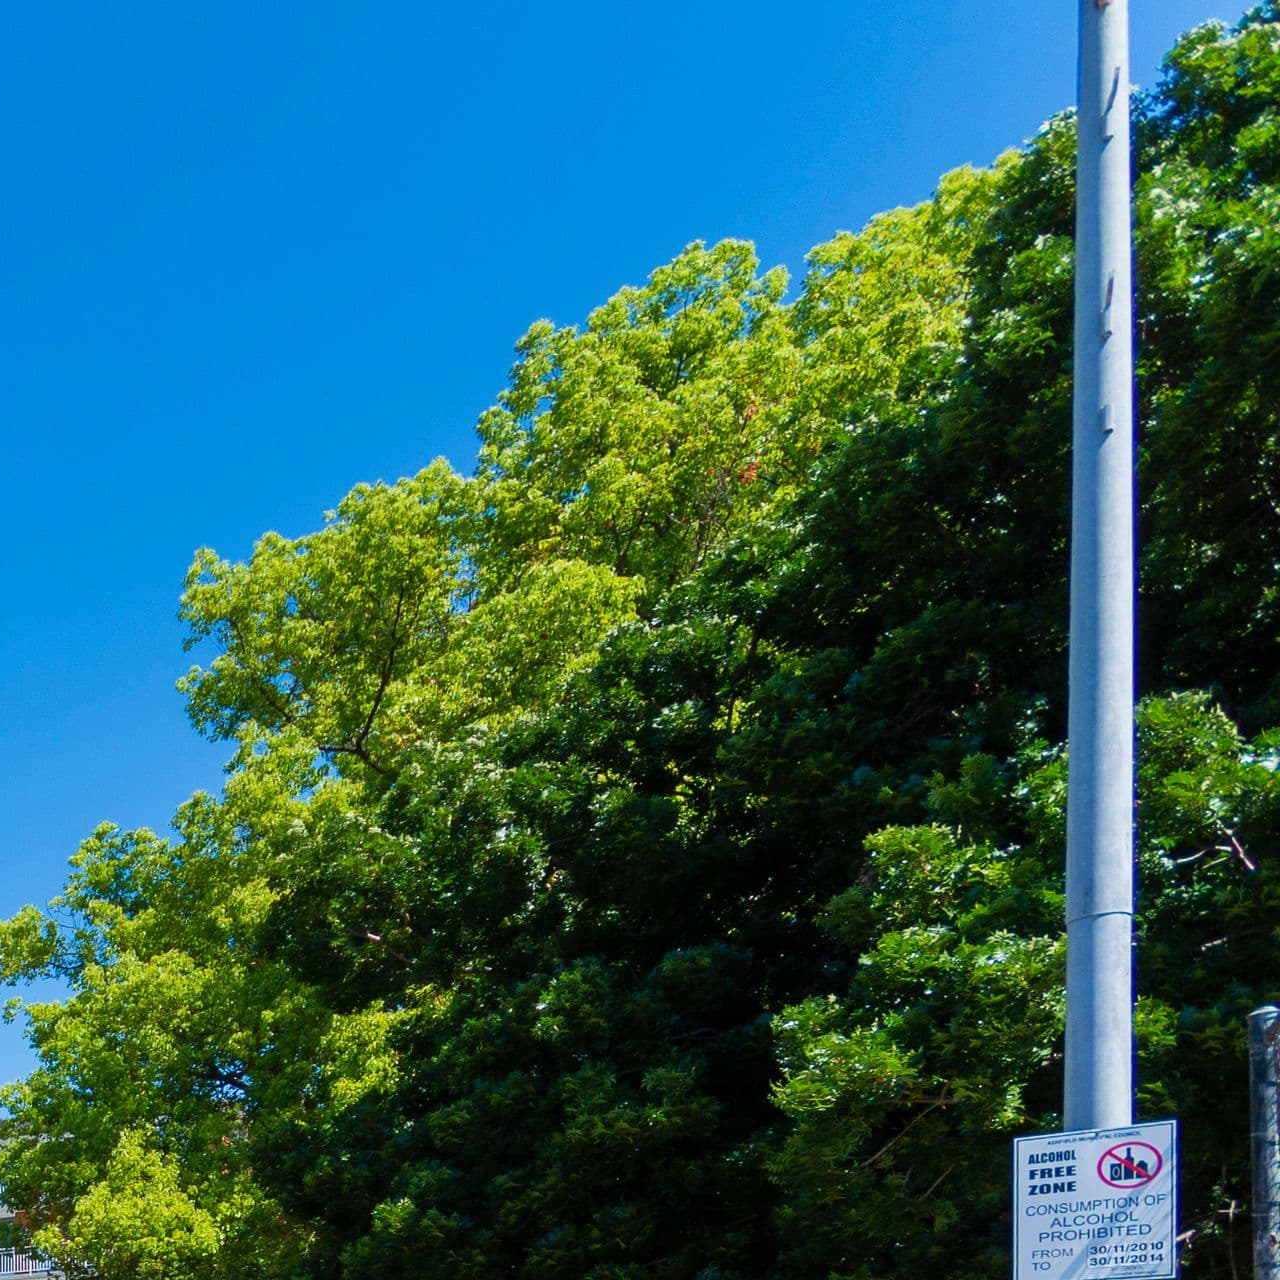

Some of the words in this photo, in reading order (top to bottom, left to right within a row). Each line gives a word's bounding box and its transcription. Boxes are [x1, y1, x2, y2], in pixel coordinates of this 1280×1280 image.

[1028, 1149, 1077, 1165] ALCOHOL
[1028, 1165, 1077, 1180] FREE
[1028, 1181, 1077, 1196] ZONE
[1025, 1197, 1139, 1216] CONSUMPTION
[1144, 1193, 1167, 1206] OF
[1050, 1211, 1140, 1228] ALCOHOL
[1039, 1224, 1152, 1243] PROHIBITED
[1031, 1248, 1074, 1260] FROM
[1032, 1261, 1052, 1271] TO
